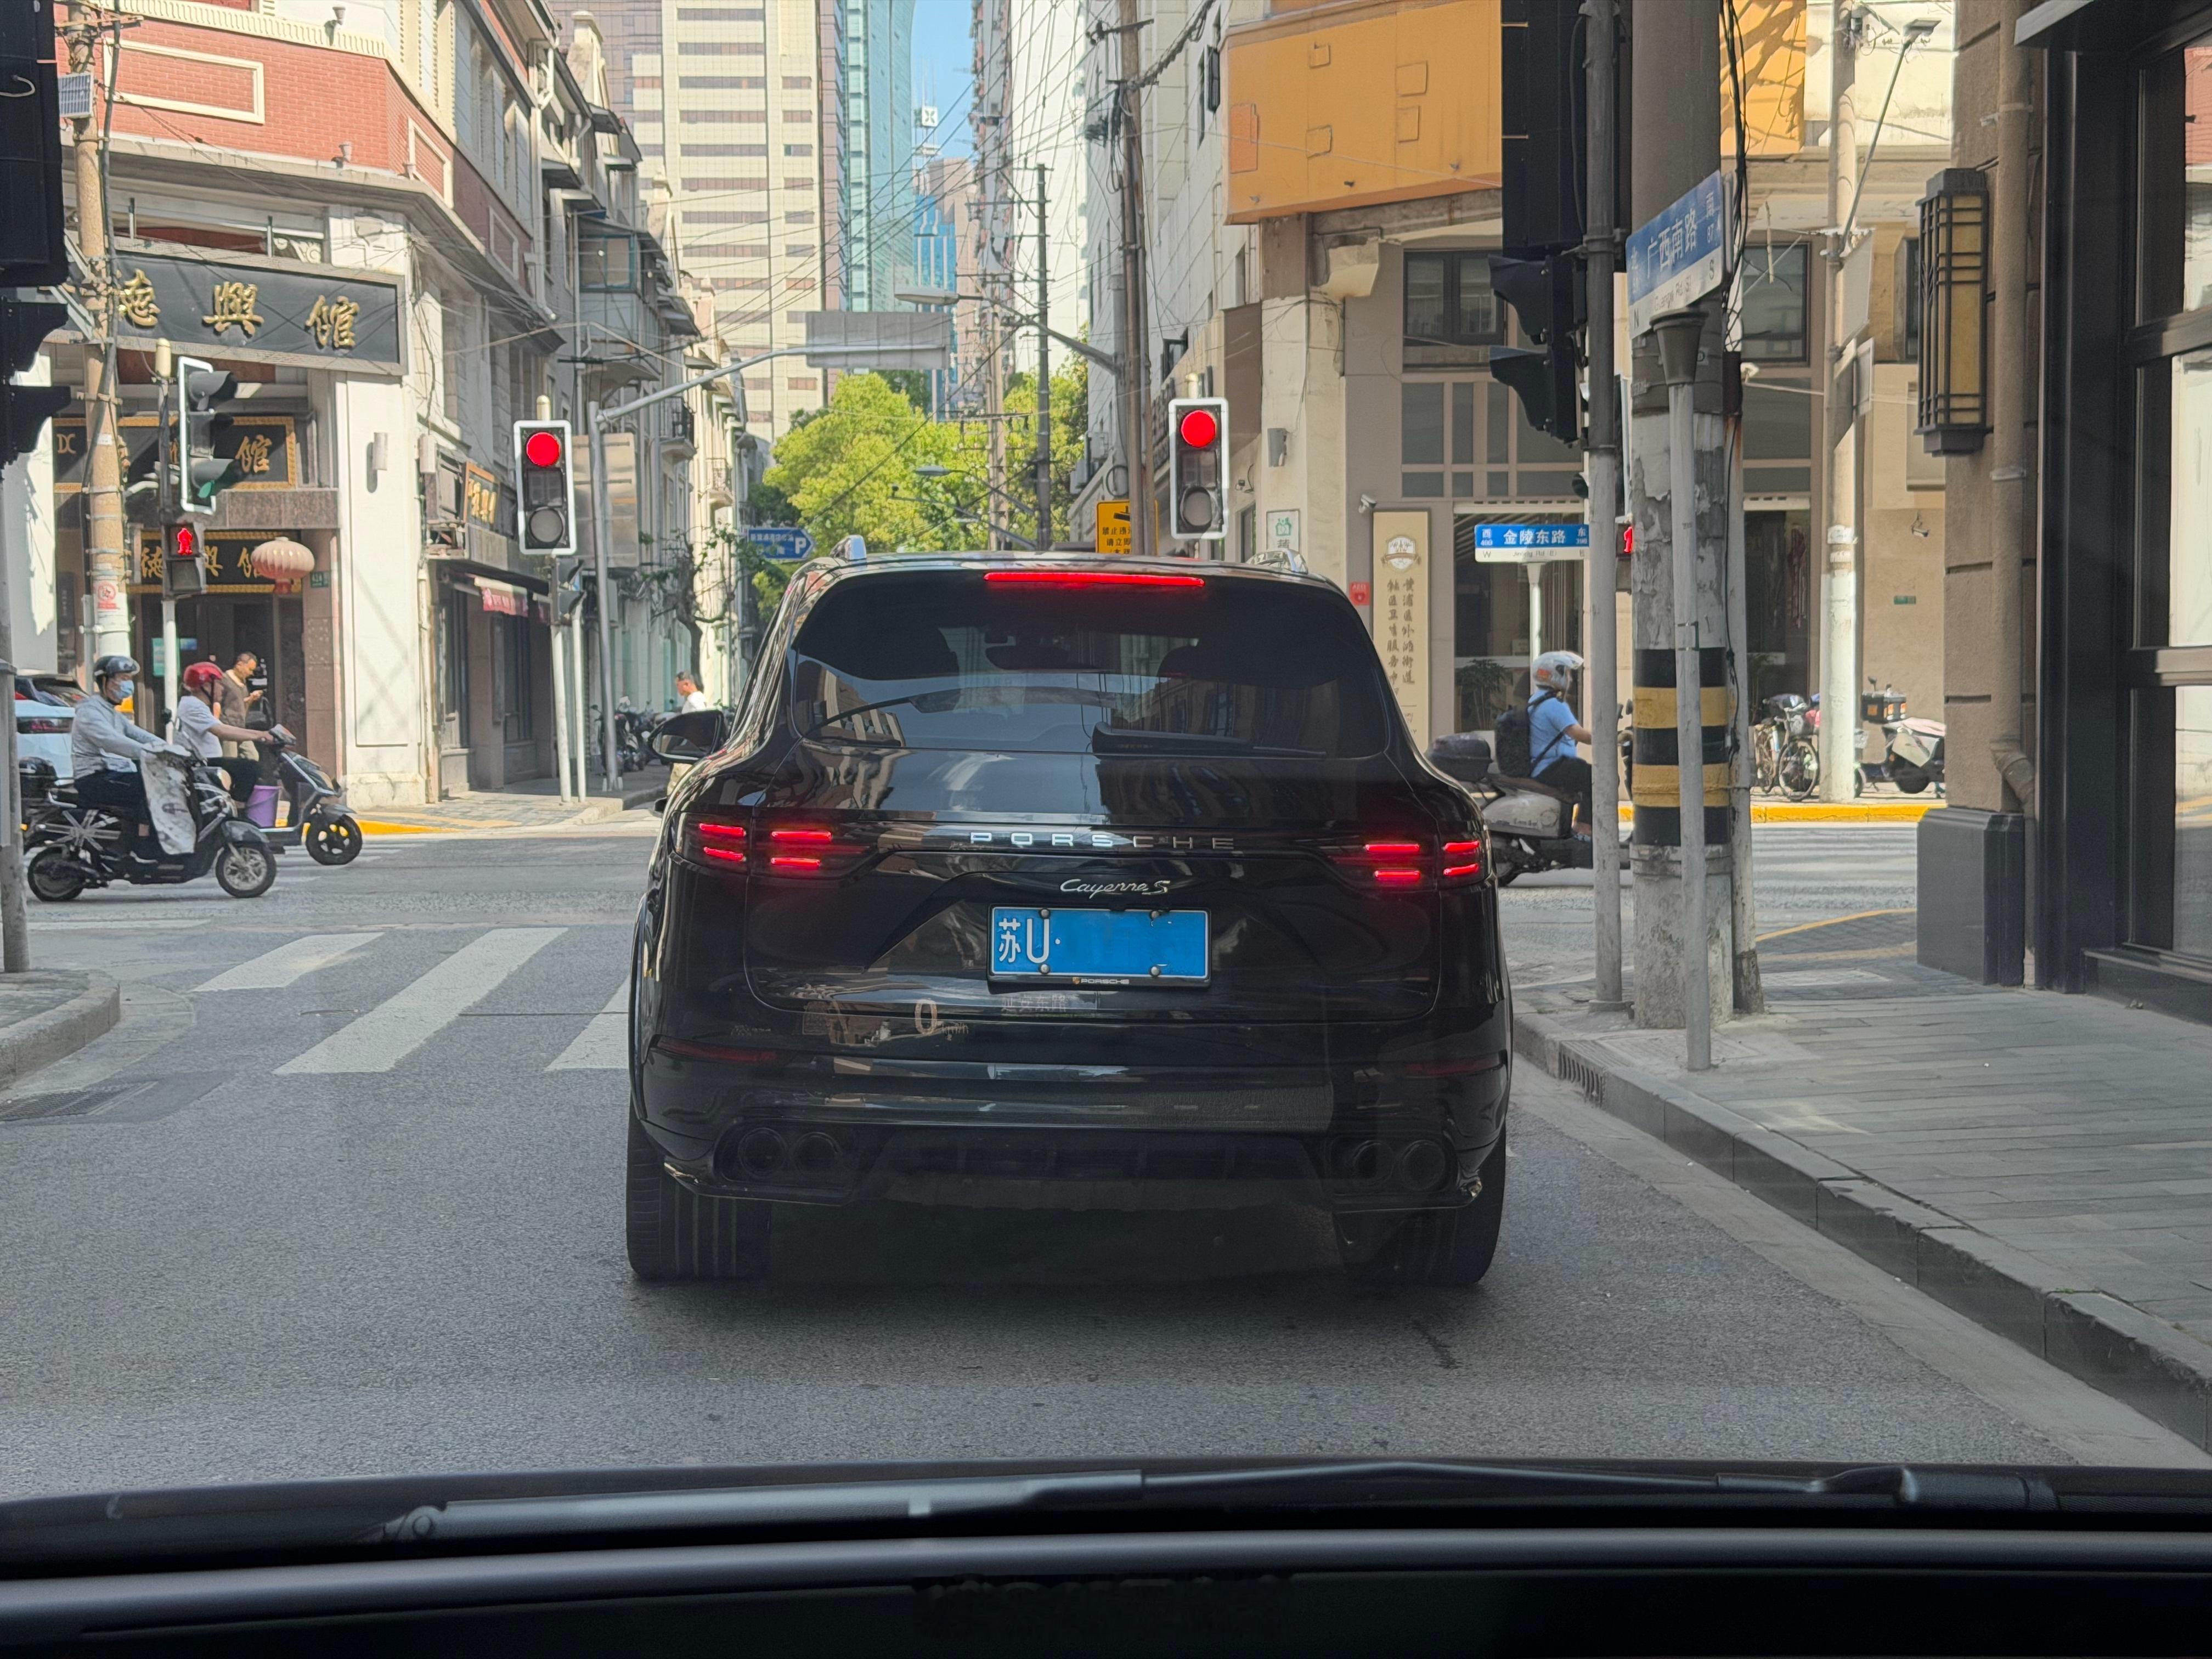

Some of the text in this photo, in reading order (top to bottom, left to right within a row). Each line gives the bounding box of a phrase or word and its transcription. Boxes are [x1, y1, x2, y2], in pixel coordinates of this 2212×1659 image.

[1647, 207, 1697, 279] 广西南路
[1709, 259, 1715, 280] S
[1634, 309, 1639, 329] N
[1482, 528, 1492, 538] 西
[1503, 529, 1565, 545] 金陵东路
[1578, 527, 1586, 537] 东
[795, 538, 806, 554] P
[970, 832, 1234, 850] PORSCHE
[1059, 878, 1171, 899] Cayenne S
